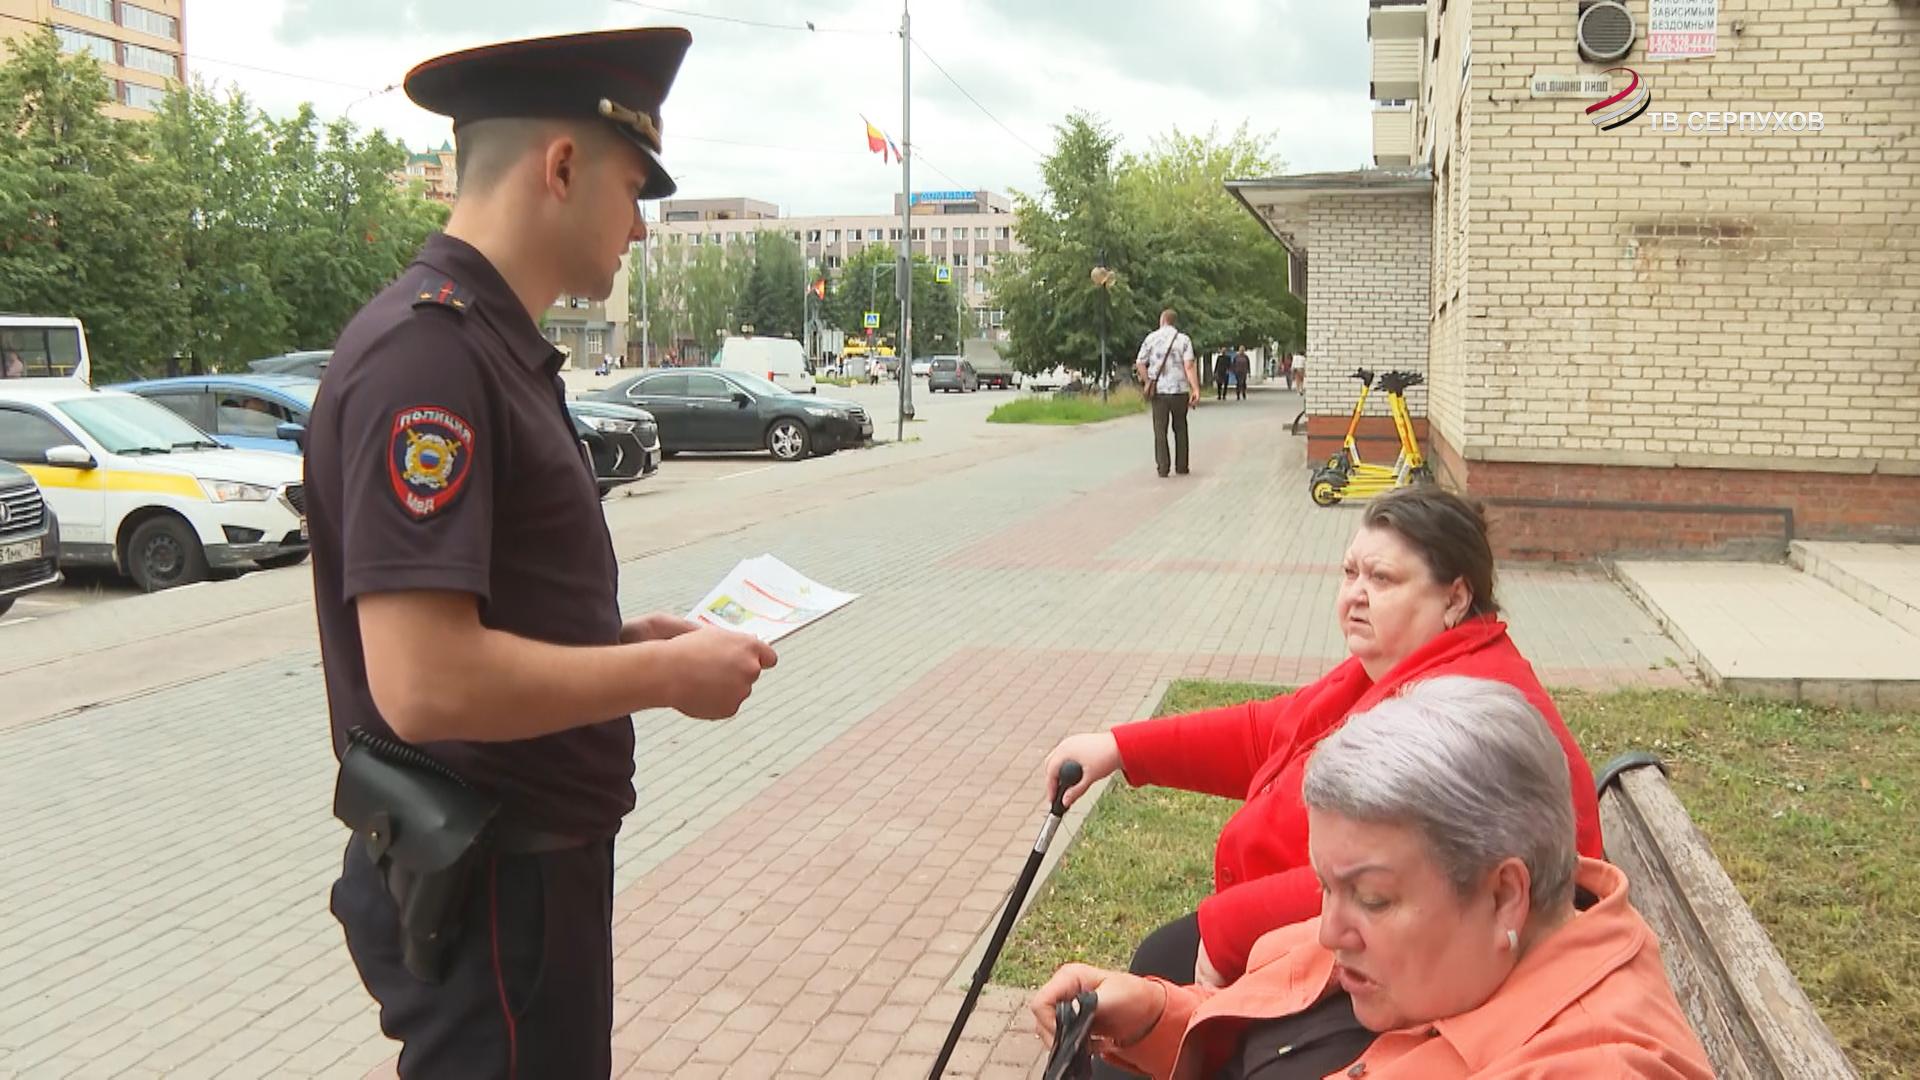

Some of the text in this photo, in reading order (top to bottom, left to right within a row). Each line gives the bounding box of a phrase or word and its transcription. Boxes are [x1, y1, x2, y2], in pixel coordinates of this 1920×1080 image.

[1652, 7, 1715, 17] ЗАВИСИМЫМ
[1652, 21, 1715, 31] БЕЗДОМНЫМ
[399, 410, 472, 444] ПОЛИЦИЯ
